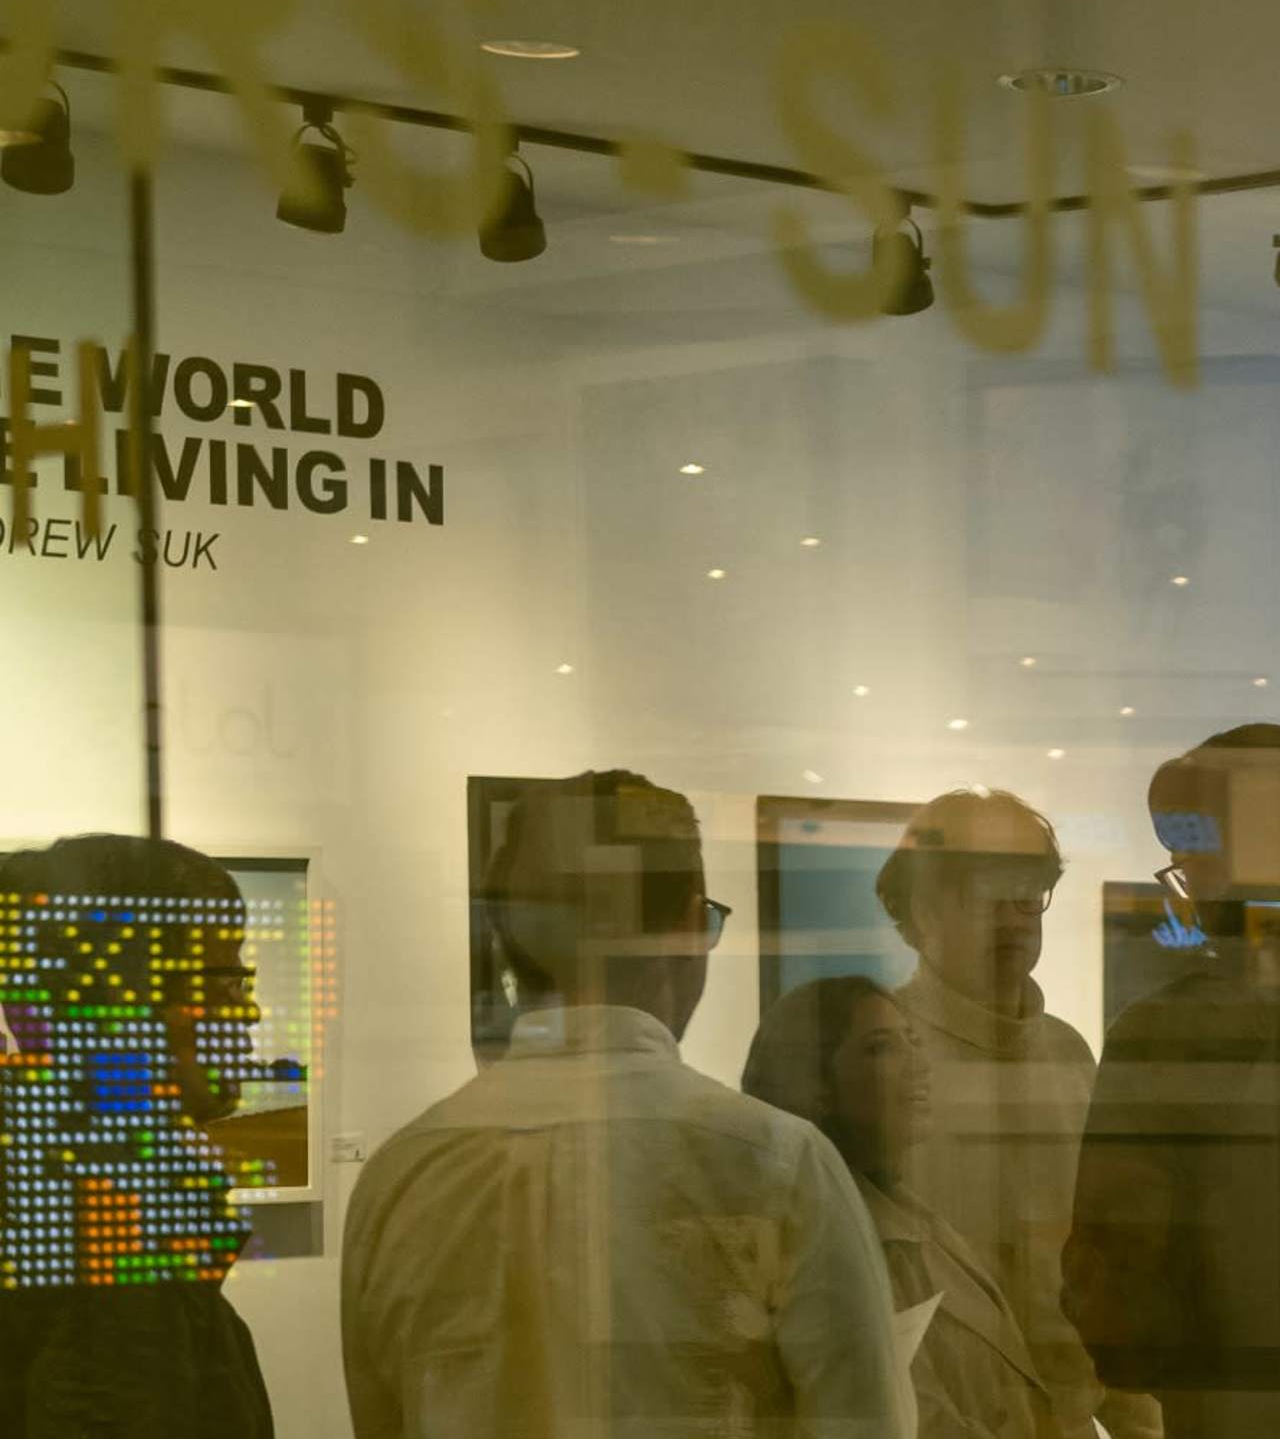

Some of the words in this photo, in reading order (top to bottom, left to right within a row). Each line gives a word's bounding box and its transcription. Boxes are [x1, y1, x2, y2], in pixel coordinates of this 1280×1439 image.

[772, 20, 1198, 395] SUN
[92, 348, 385, 440] WORLD
[64, 425, 349, 514] LIVING
[369, 459, 445, 526] IN
[0, 516, 117, 562] REW
